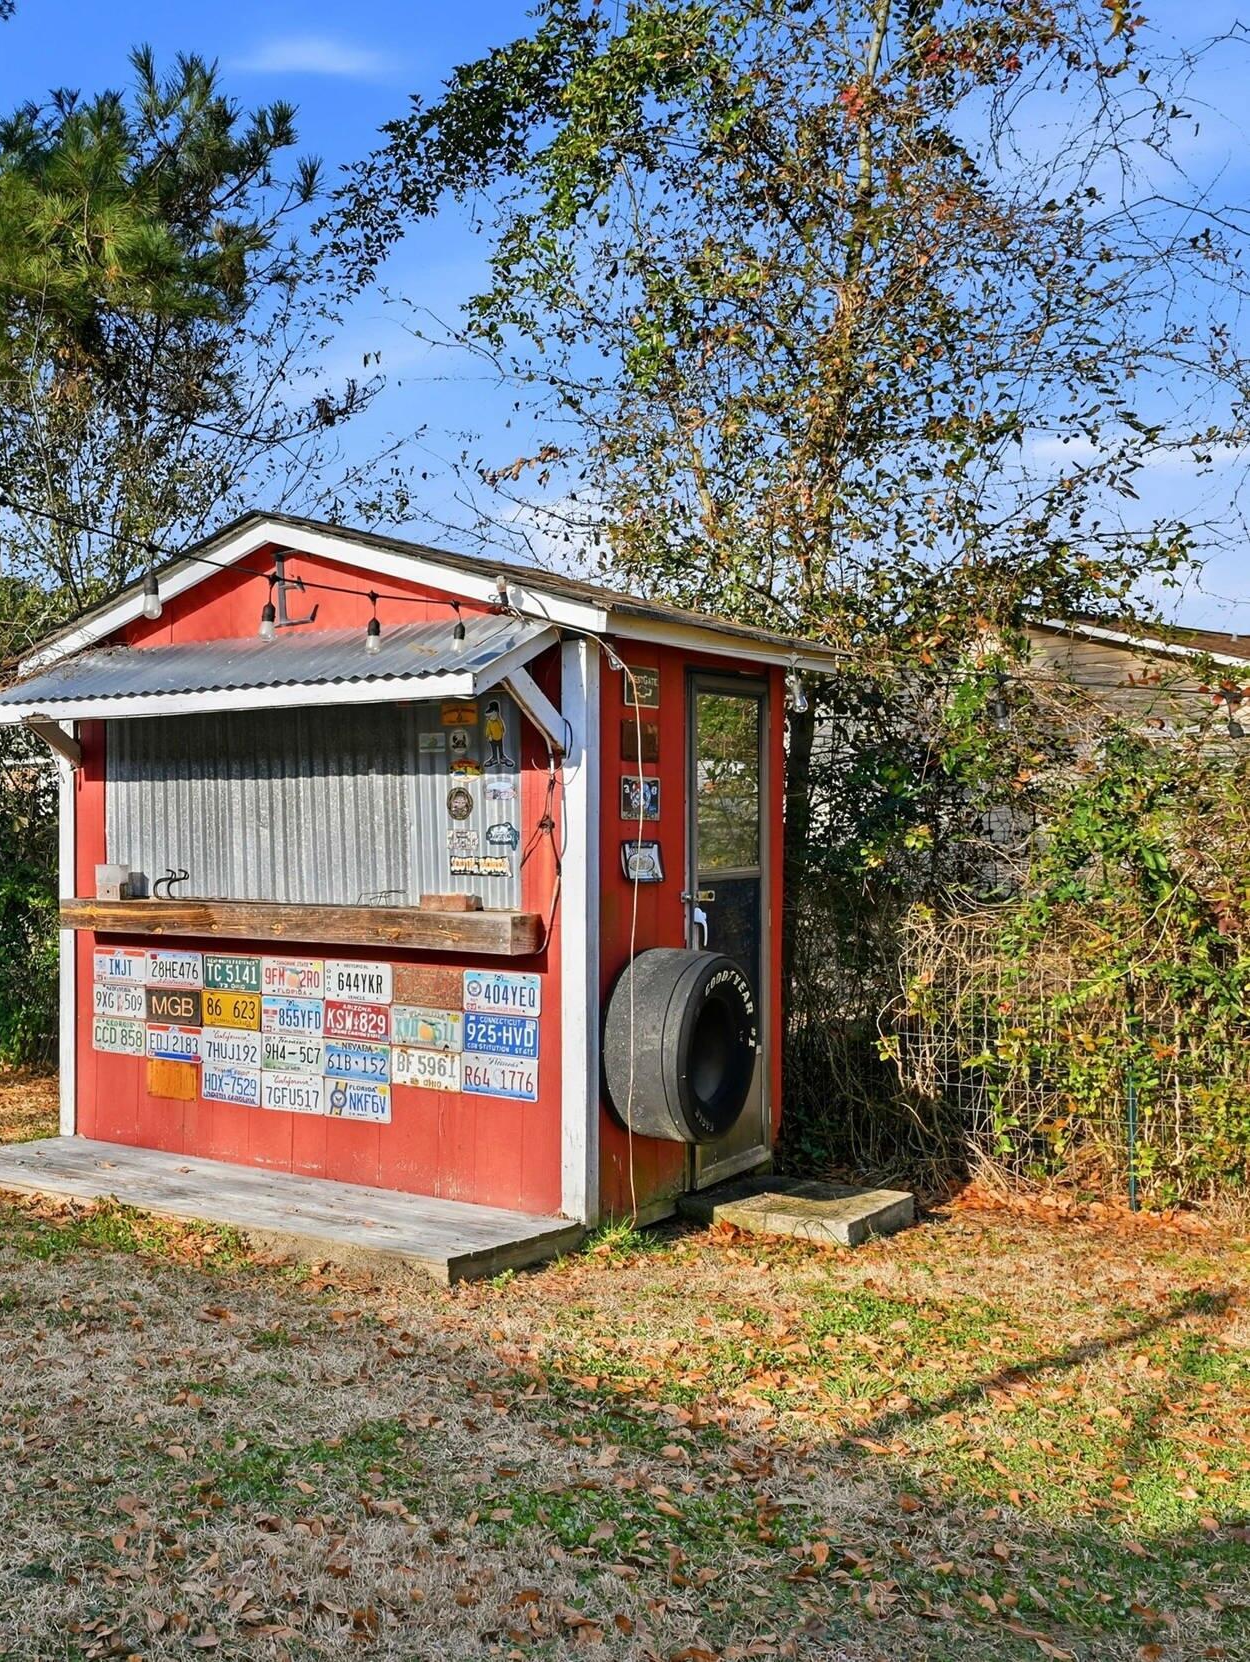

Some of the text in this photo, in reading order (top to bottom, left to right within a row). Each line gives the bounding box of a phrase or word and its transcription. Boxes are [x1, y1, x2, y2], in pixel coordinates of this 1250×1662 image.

[151, 960, 199, 980] 28HE476
[206, 963, 257, 984] TC 5141
[337, 972, 383, 994] 644YKR
[705, 970, 753, 1015] GOODYEAR
[124, 994, 143, 1011] 509
[151, 995, 194, 1017] MGB
[484, 983, 536, 1008] 404YEQ
[206, 998, 256, 1020] 86 623
[359, 1012, 386, 1035] 829
[120, 1029, 143, 1048] 858
[172, 1036, 199, 1055] 2183
[397, 1053, 414, 1072] BF
[465, 1065, 533, 1093] R64 1776
